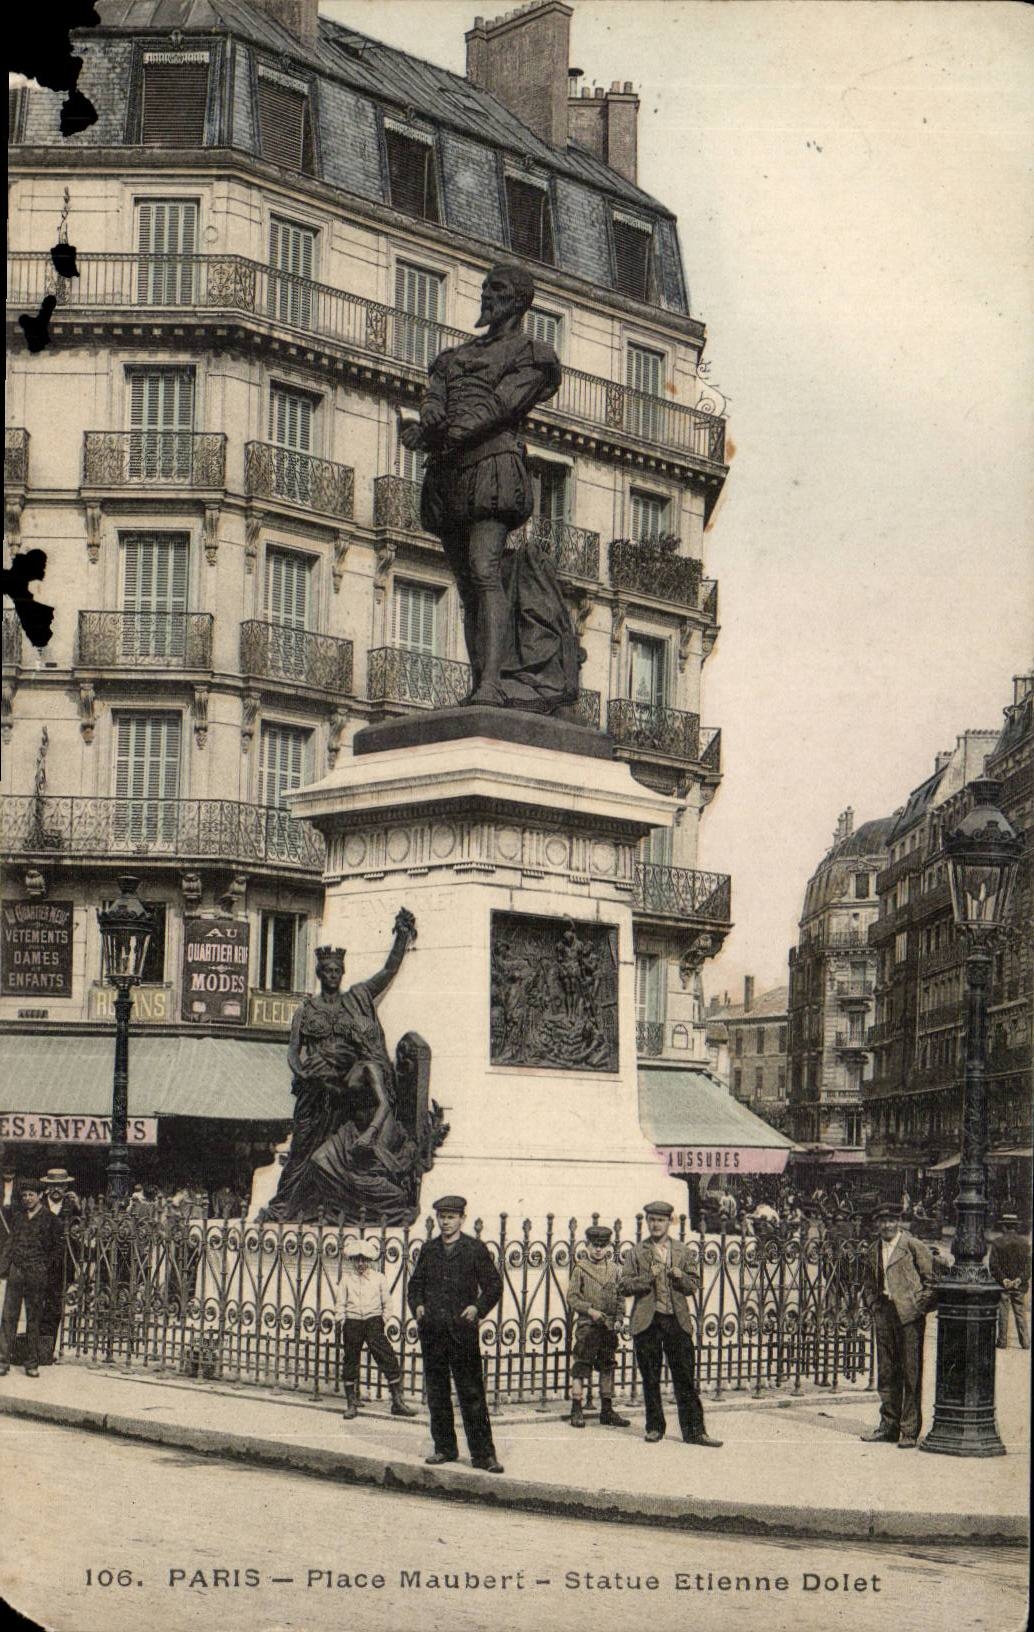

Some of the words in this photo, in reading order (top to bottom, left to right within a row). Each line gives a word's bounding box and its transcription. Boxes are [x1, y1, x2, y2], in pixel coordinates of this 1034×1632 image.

[206, 928, 238, 938] AU
[14, 951, 60, 966] DAMES
[187, 943, 232, 963] QUARTIER
[8, 972, 64, 988] ENFANTS
[190, 973, 245, 993] MODES
[97, 992, 166, 1017] RUANS
[39, 1118, 146, 1140] ENFANS
[667, 1151, 741, 1168] AUSSURES
